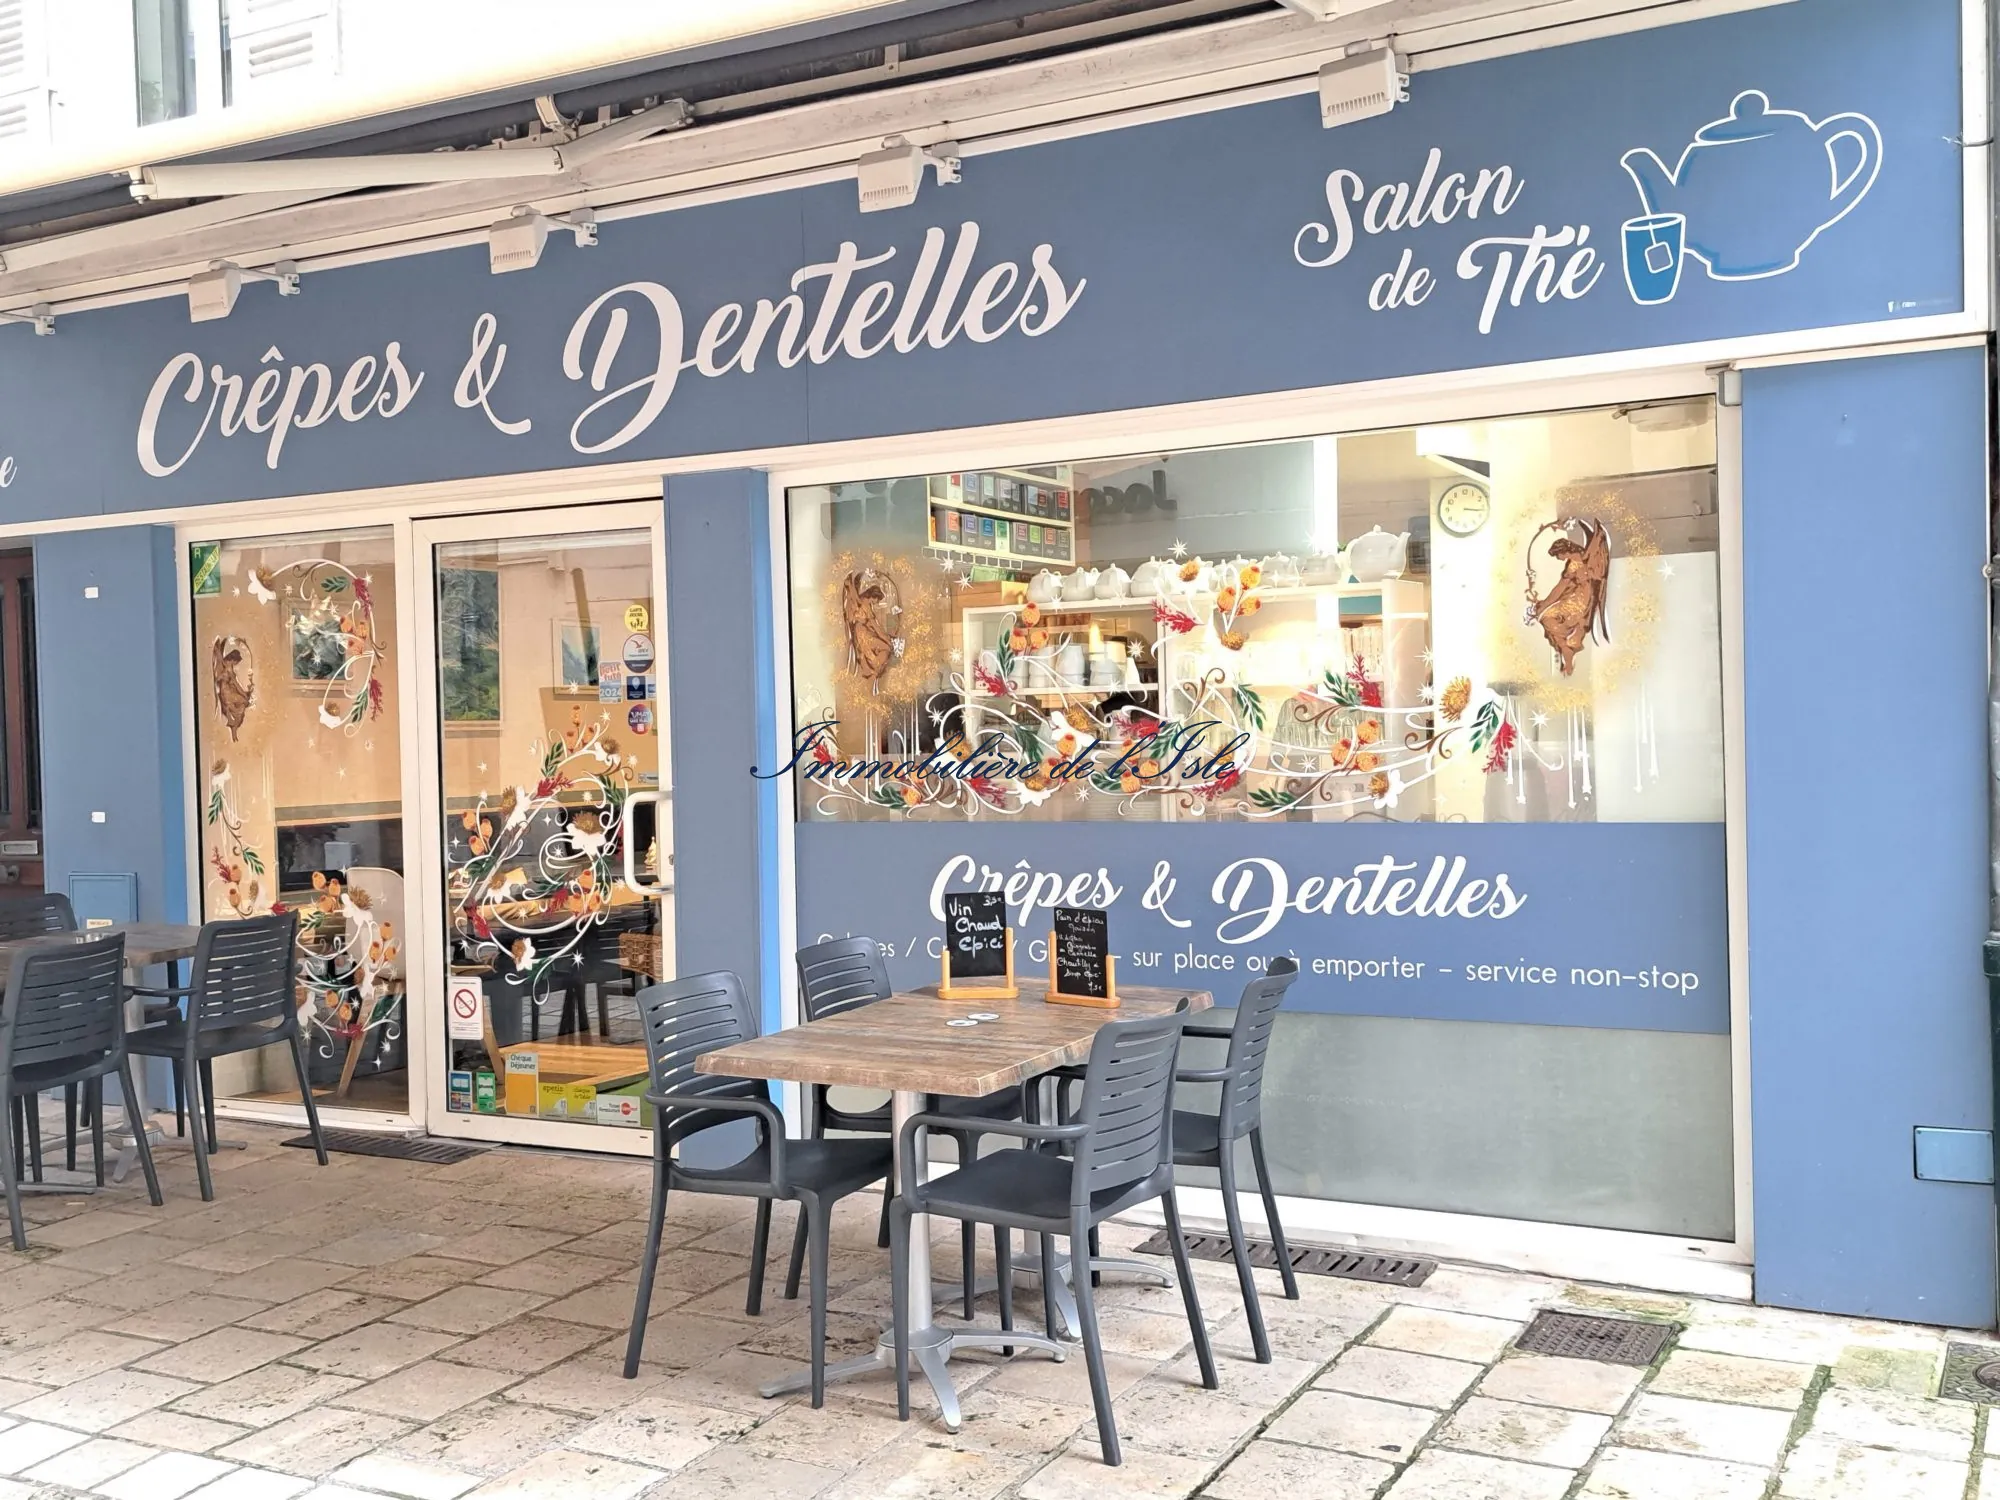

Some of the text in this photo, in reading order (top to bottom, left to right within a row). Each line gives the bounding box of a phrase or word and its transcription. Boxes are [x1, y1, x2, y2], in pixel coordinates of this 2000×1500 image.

[1294, 147, 1525, 268] Salon
[1368, 223, 1606, 335] de Thé
[137, 221, 1087, 478] Crêpes & Dentelles
[929, 854, 1528, 945] Crêpes & Dentelles
[948, 897, 973, 917] Vin
[955, 914, 1004, 934] Chaud
[1133, 951, 1160, 967] sur
[1174, 943, 1235, 973] place
[1312, 954, 1426, 982] emporter
[1466, 958, 1557, 985] service
